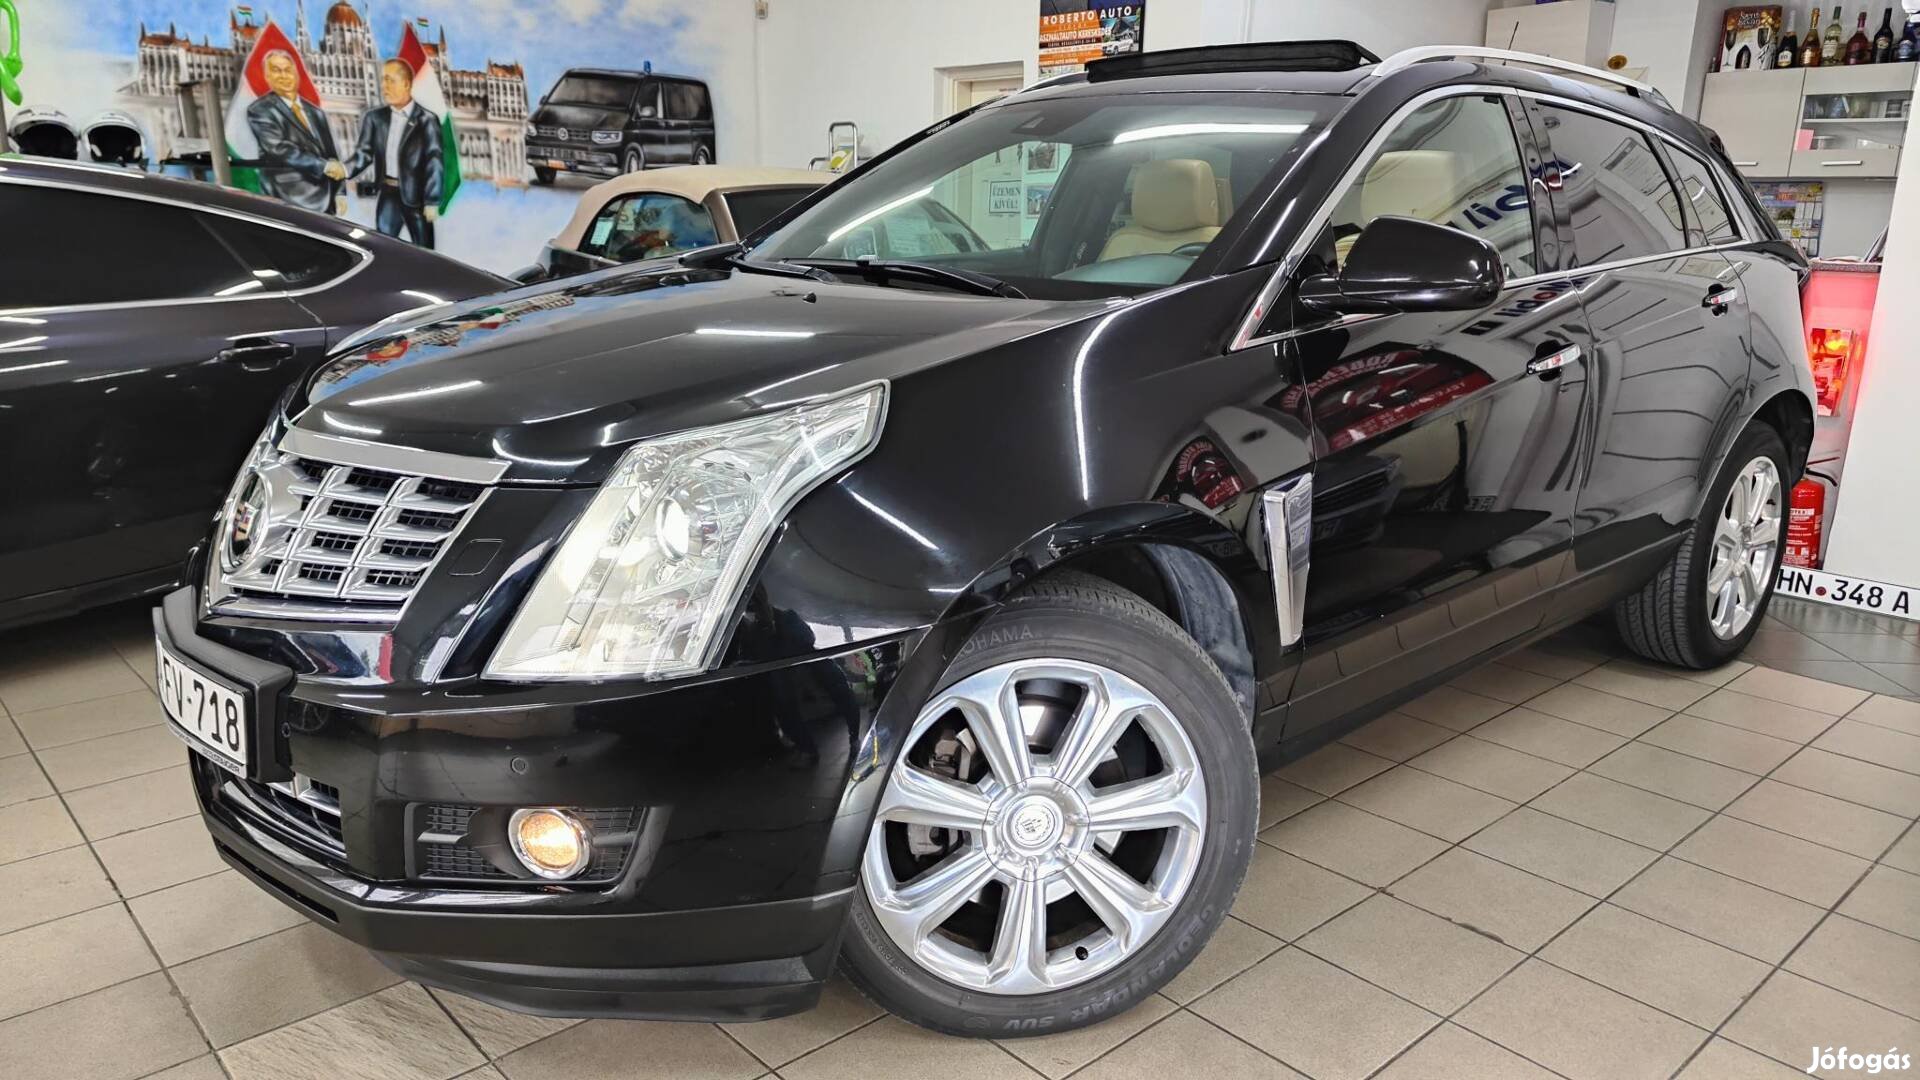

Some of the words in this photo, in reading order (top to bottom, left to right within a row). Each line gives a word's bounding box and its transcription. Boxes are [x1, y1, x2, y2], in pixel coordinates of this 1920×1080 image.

[1043, 10, 1095, 26] ROBERTO
[1776, 568, 1813, 595] HN
[1831, 579, 1884, 608] 348
[1892, 591, 1909, 614] A
[962, 623, 1034, 654] OHAMA
[161, 655, 240, 752] FV-718
[1070, 900, 1214, 1022] GEOLANDAR
